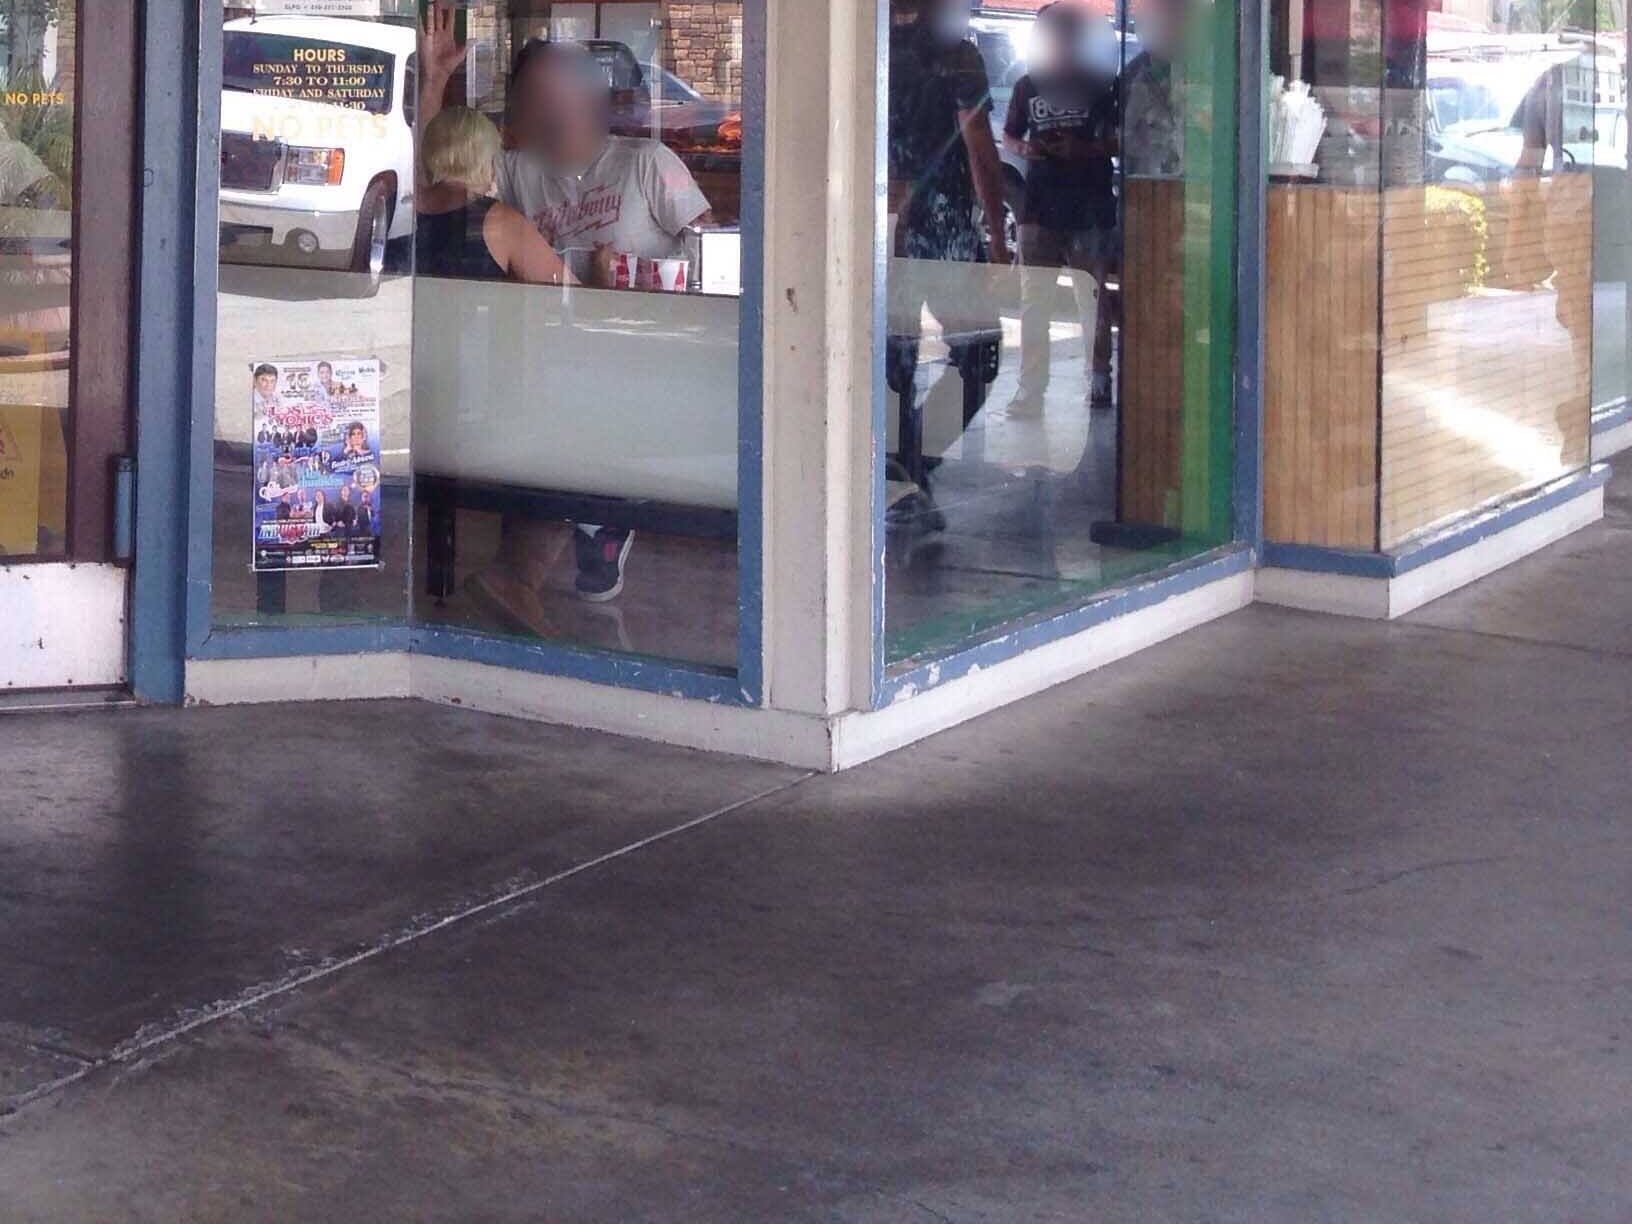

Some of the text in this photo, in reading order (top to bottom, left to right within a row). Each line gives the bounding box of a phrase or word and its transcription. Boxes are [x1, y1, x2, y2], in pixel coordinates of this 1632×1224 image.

[293, 48, 346, 63] HOURS
[252, 63, 385, 74] SUNDAY TO THURSDAY
[273, 76, 366, 86] 7:30 TO 11:00
[5, 92, 64, 105] NO PETS
[252, 88, 385, 98] FRIDAY AND SATURDAY
[252, 112, 387, 142] NO PETS
